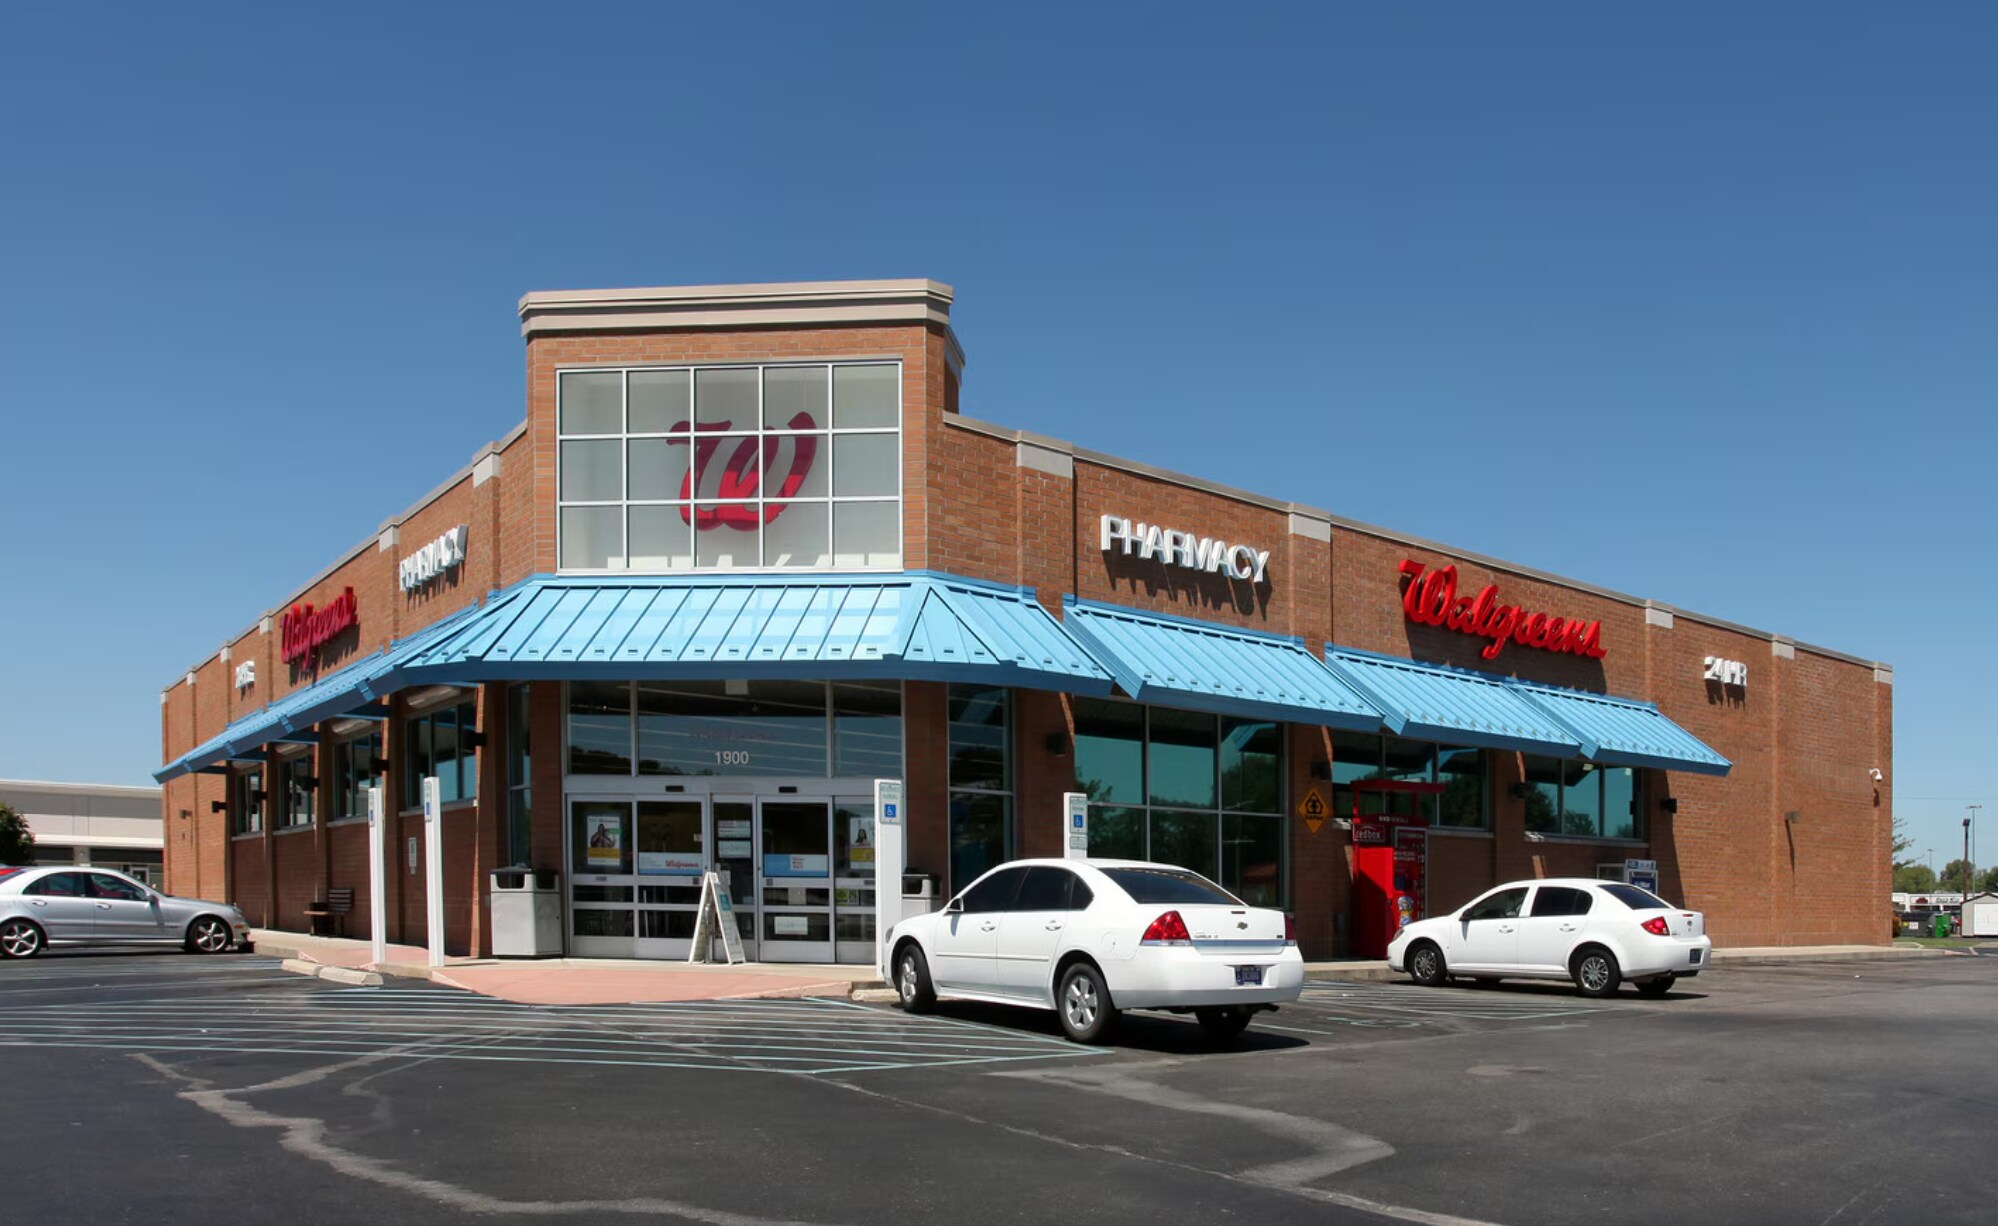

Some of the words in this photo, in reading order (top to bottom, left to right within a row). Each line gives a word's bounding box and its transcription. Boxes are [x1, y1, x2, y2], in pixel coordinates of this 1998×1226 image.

[398, 524, 469, 592] PHARMACY
[1100, 514, 1270, 582] PHARMACY
[280, 586, 358, 671] Walgreens
[1398, 559, 1608, 660] Walgreens
[714, 751, 750, 765] 1900
[665, 860, 699, 869] Walgreens
